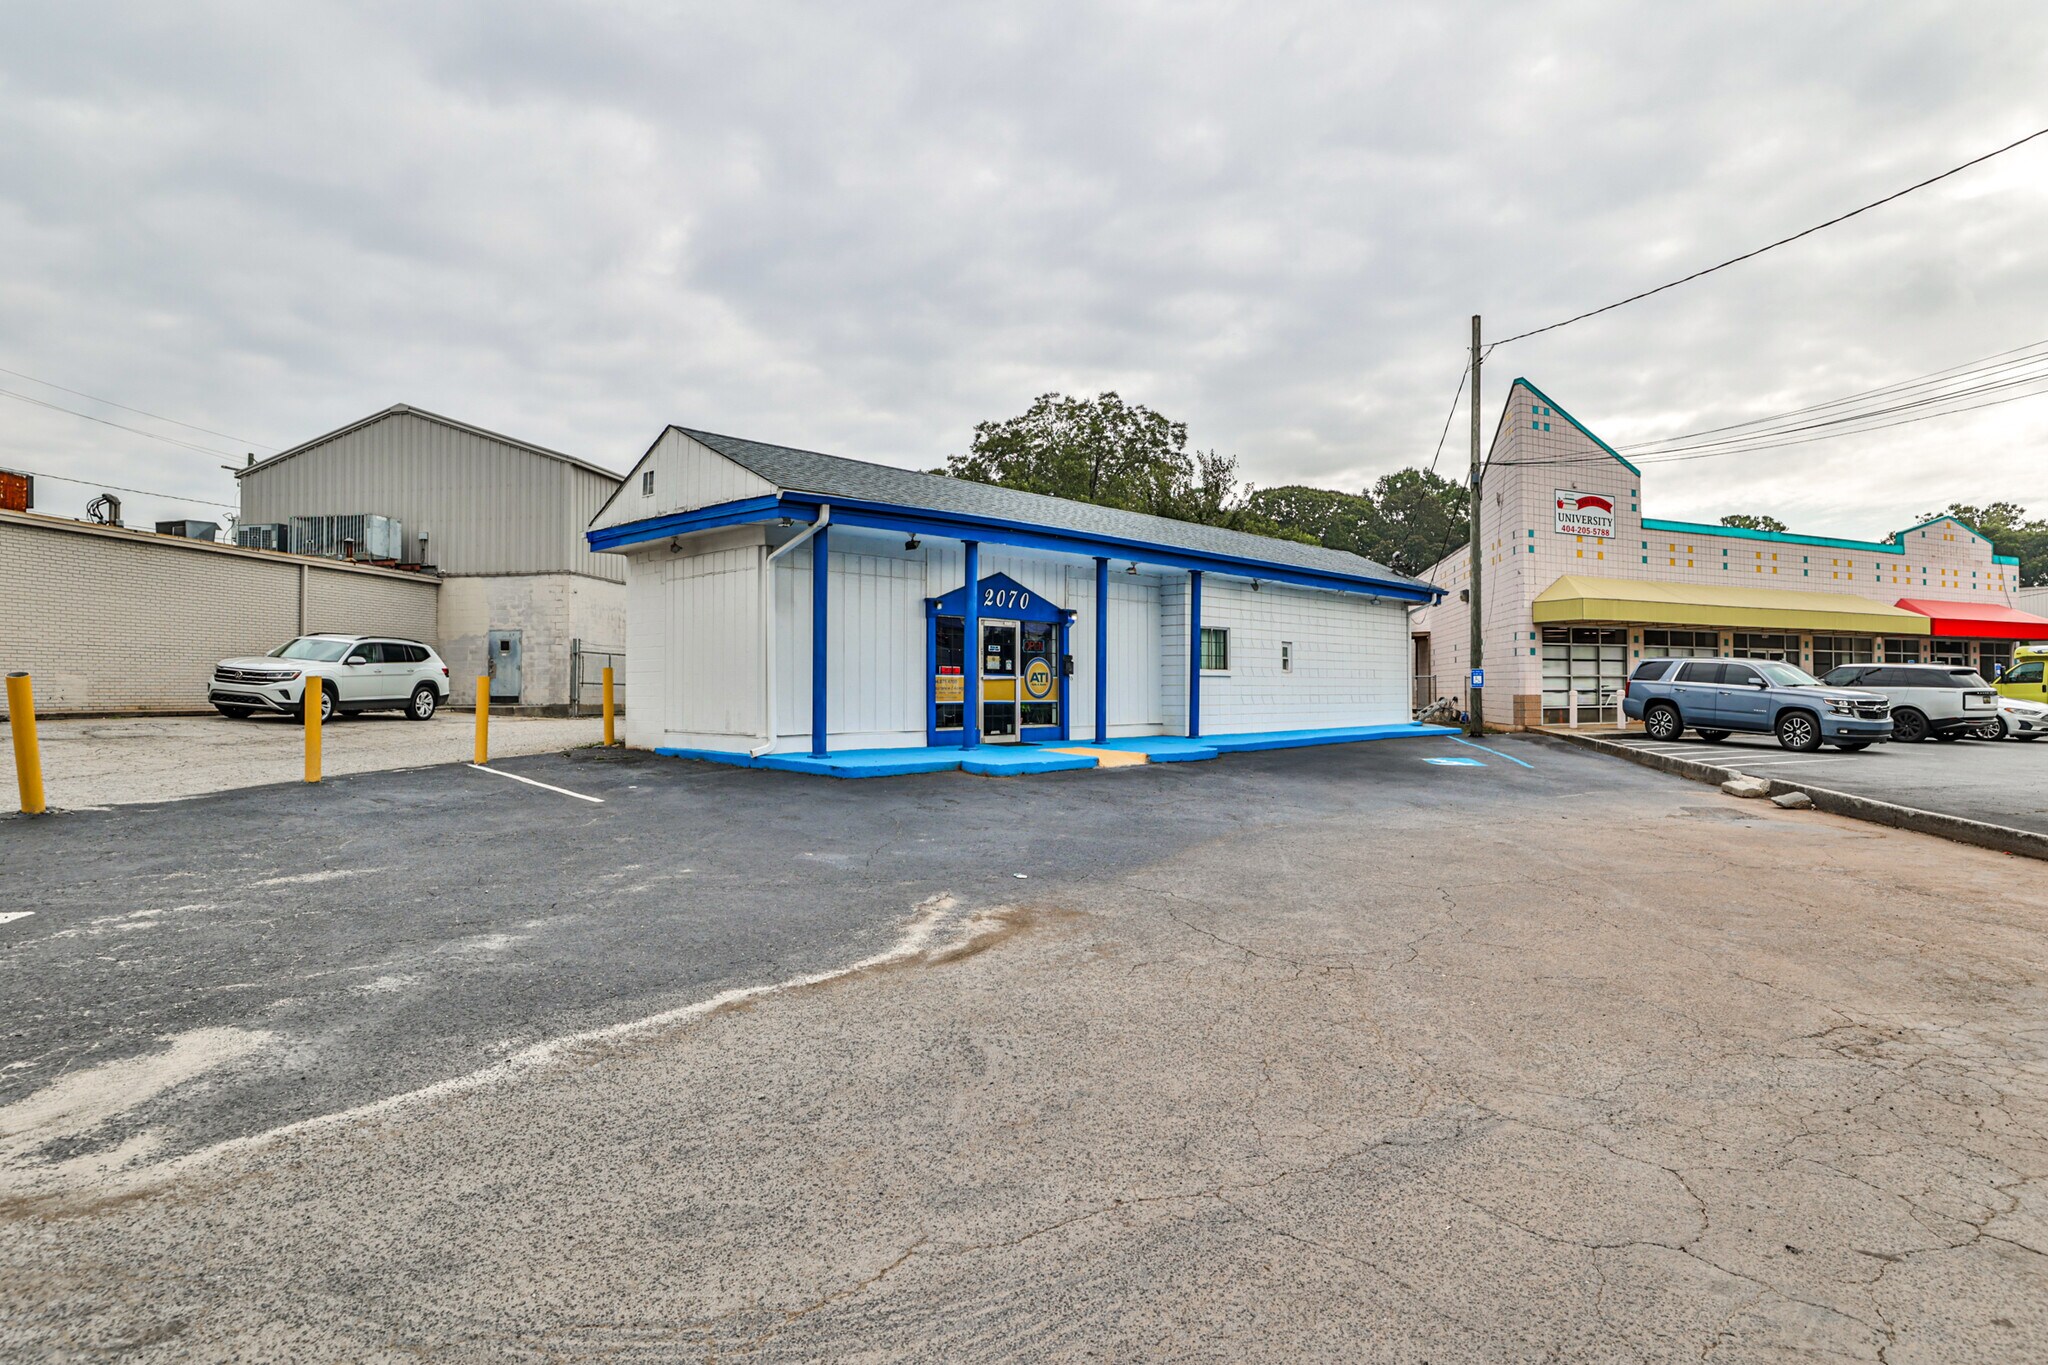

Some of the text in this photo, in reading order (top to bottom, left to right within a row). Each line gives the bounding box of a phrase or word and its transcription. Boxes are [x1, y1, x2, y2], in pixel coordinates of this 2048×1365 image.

[1558, 512, 1613, 527] UNIVERSITY
[1561, 525, 1609, 536] 404-205-5788
[983, 588, 1029, 610] 2070
[1024, 640, 1043, 651] OPEN
[1030, 672, 1048, 683] ATI
